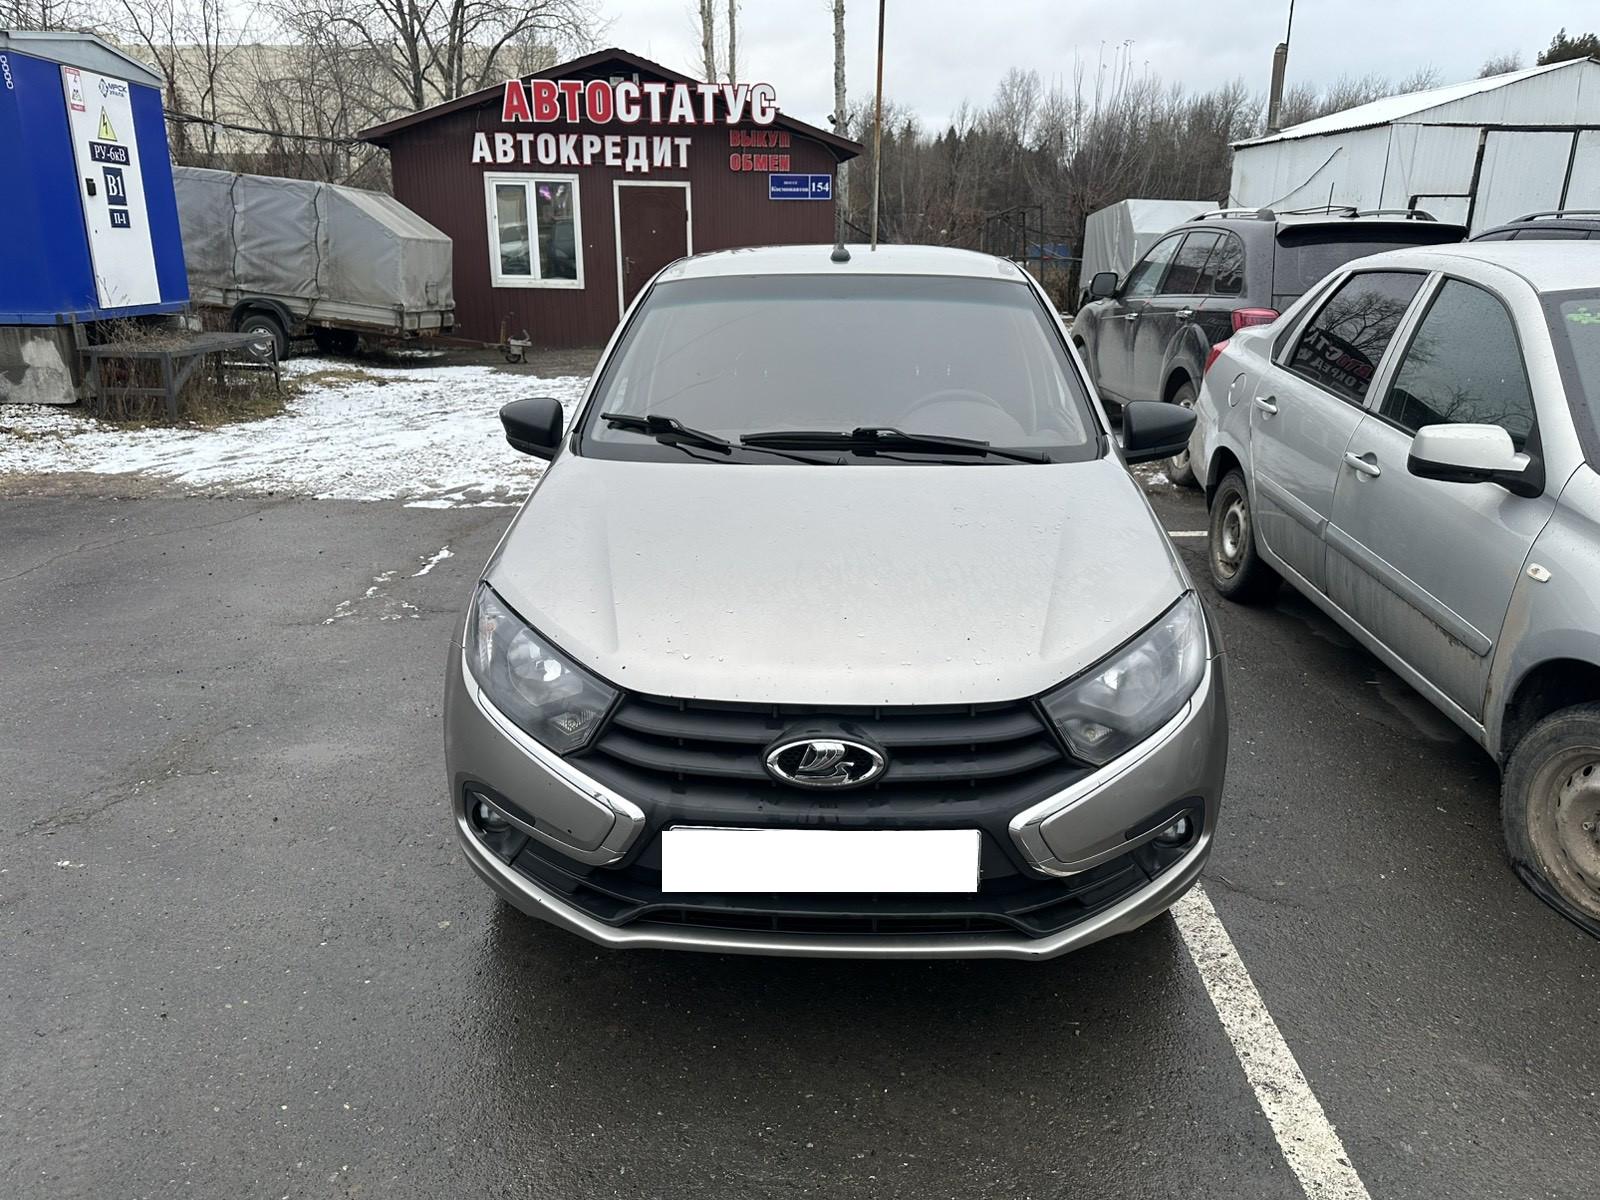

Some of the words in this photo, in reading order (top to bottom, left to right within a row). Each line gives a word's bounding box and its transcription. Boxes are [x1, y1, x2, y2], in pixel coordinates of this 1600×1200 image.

[501, 79, 777, 125] АВТОСТАТУС
[729, 130, 790, 148] ВЫКУП
[94, 144, 126, 162] РУ-6кВ
[471, 132, 692, 172] АВТОКРЕДИТ
[729, 153, 790, 171] ОБМЕН
[106, 174, 124, 197] В1
[811, 182, 829, 192] 154
